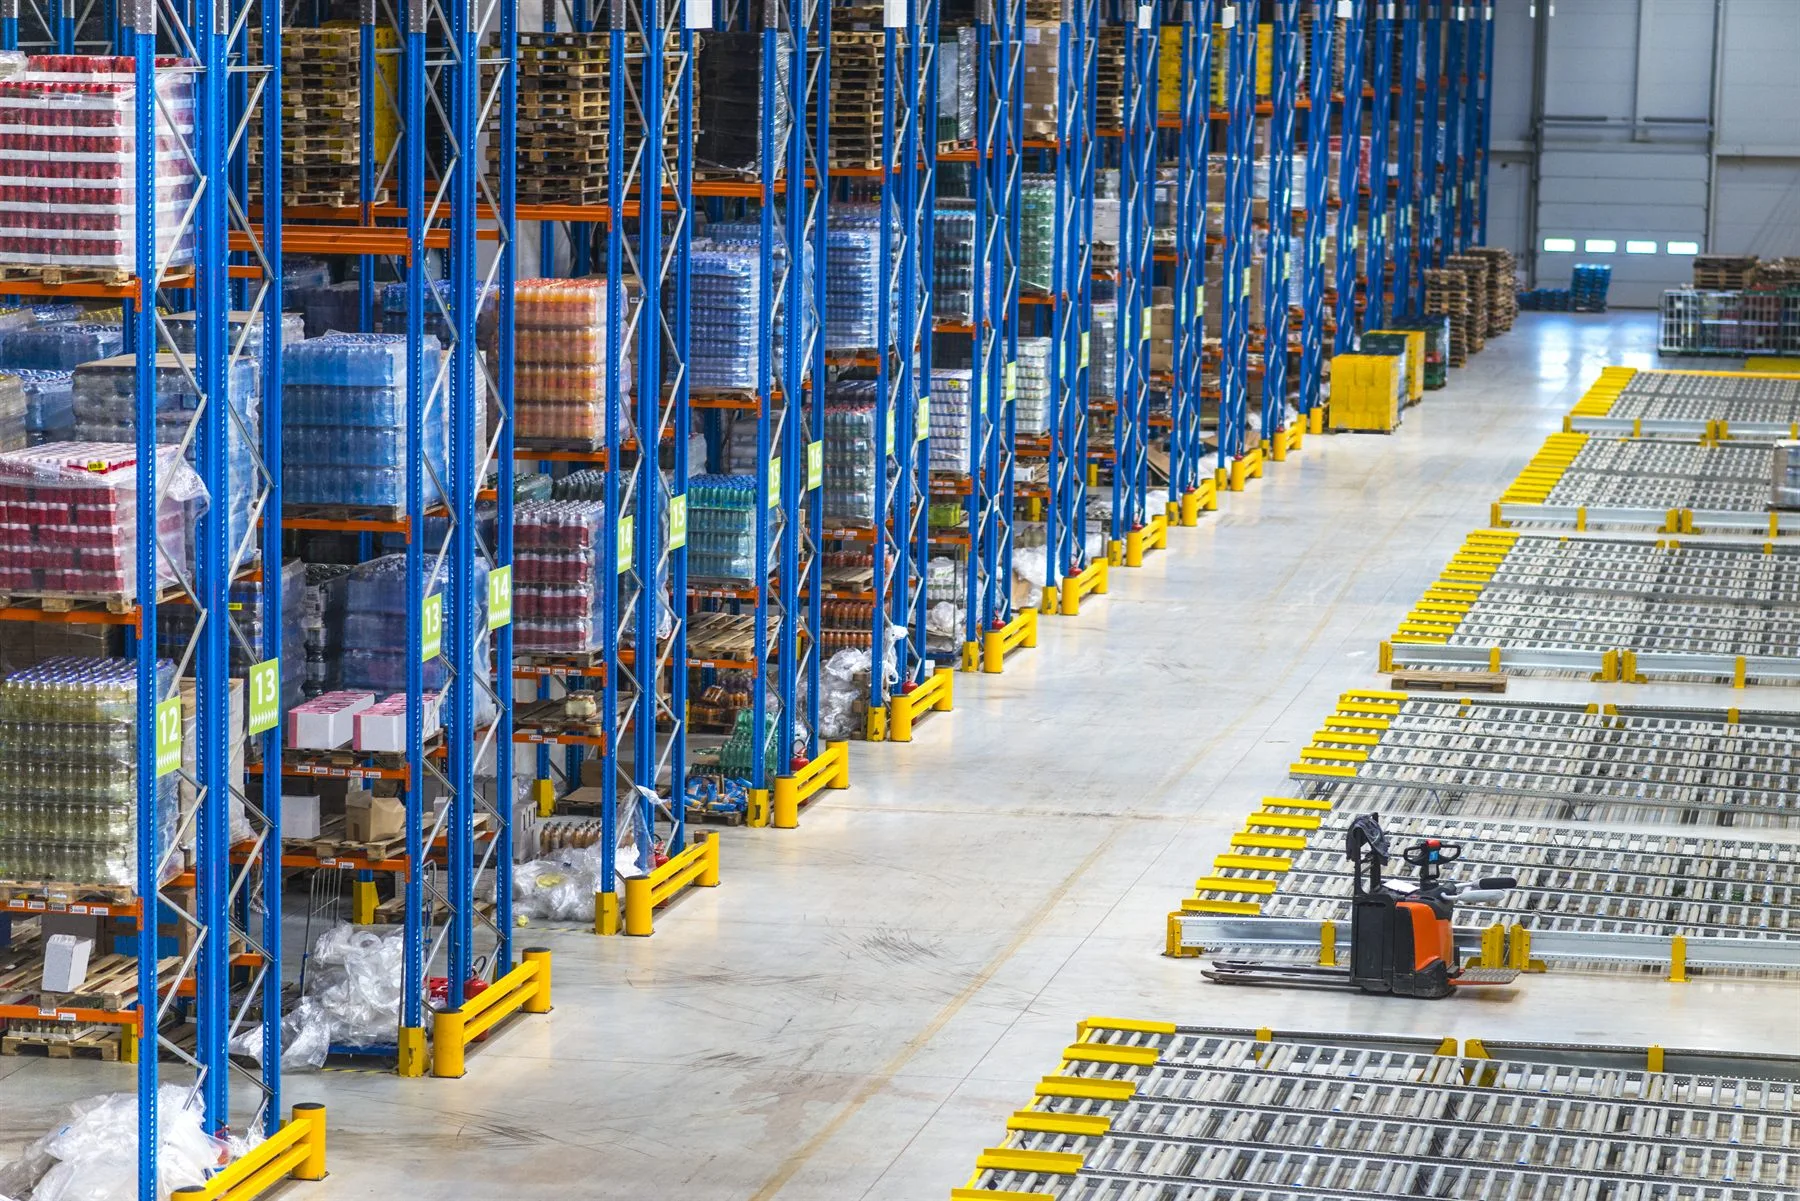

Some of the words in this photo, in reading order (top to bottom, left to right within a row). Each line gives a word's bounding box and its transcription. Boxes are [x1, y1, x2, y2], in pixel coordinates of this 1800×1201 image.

[811, 446, 822, 472] 16
[673, 501, 685, 529] 15
[620, 523, 631, 552] 14
[493, 573, 509, 605] 14
[425, 602, 439, 635] 13
[255, 668, 276, 705] 13
[160, 706, 178, 746] 12
